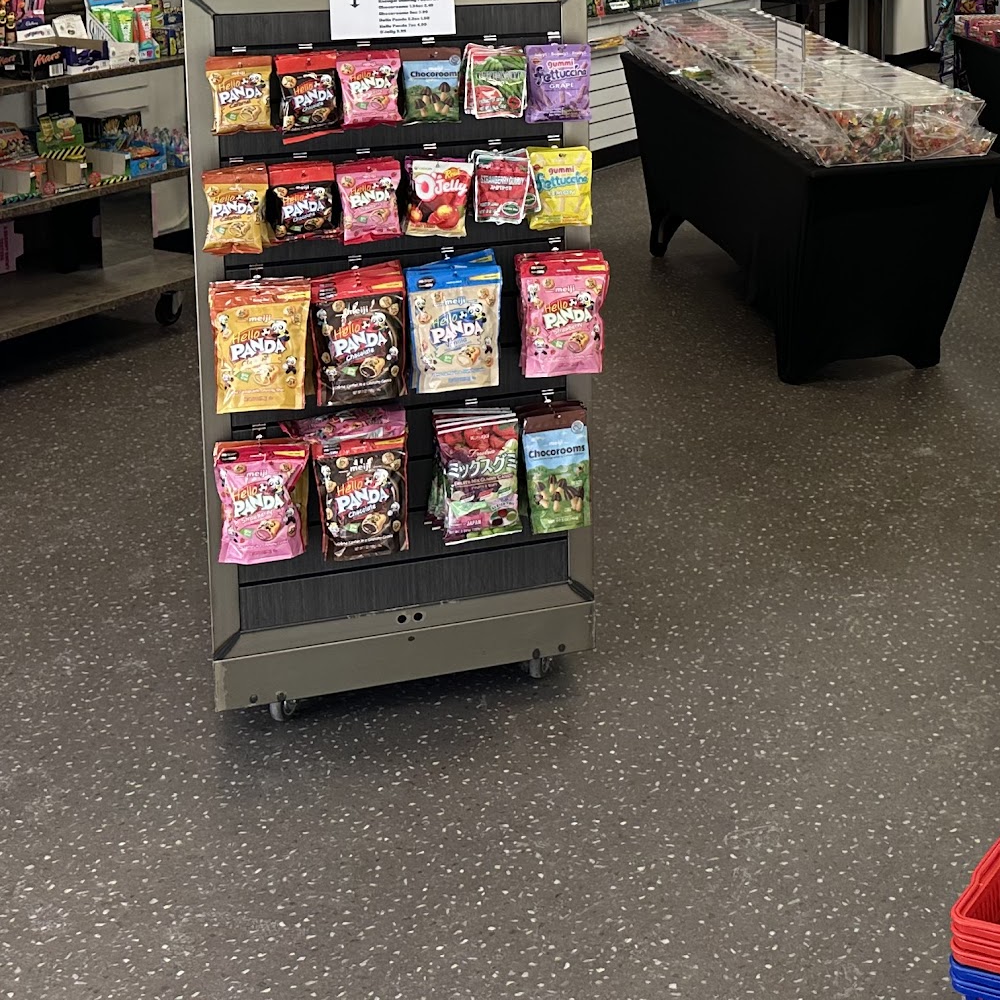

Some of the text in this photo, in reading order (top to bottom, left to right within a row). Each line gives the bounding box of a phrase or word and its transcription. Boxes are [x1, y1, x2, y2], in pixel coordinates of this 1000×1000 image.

[34, 51, 61, 67] Mars
[548, 59, 574, 69] gummi
[218, 77, 240, 92] Hello
[351, 70, 372, 83] Hello
[293, 80, 314, 95] Hello
[350, 76, 392, 96] PANDA
[219, 87, 262, 105] PANDA
[294, 90, 333, 109] PANDA
[548, 167, 575, 175] gummi
[282, 191, 305, 205] Hello
[350, 184, 372, 196] Hello
[349, 190, 392, 209] PANDA
[211, 201, 254, 218] PANDA
[282, 200, 325, 219] PANDA
[555, 286, 575, 294] meiji
[544, 299, 569, 313] Hello
[249, 315, 273, 323] meiji
[431, 314, 459, 329] Hello
[543, 308, 593, 330] PANDA
[231, 329, 261, 344] Hello
[334, 323, 362, 341] Hello
[430, 320, 485, 345] PANDA
[230, 338, 286, 361] PANDA
[334, 332, 388, 357] PANDA
[528, 445, 586, 459] Chocorooms
[246, 470, 268, 478] meiji
[233, 485, 258, 501] Hello
[336, 480, 364, 496] Hello
[232, 493, 285, 518] PANDA
[334, 488, 390, 514] PANDA
